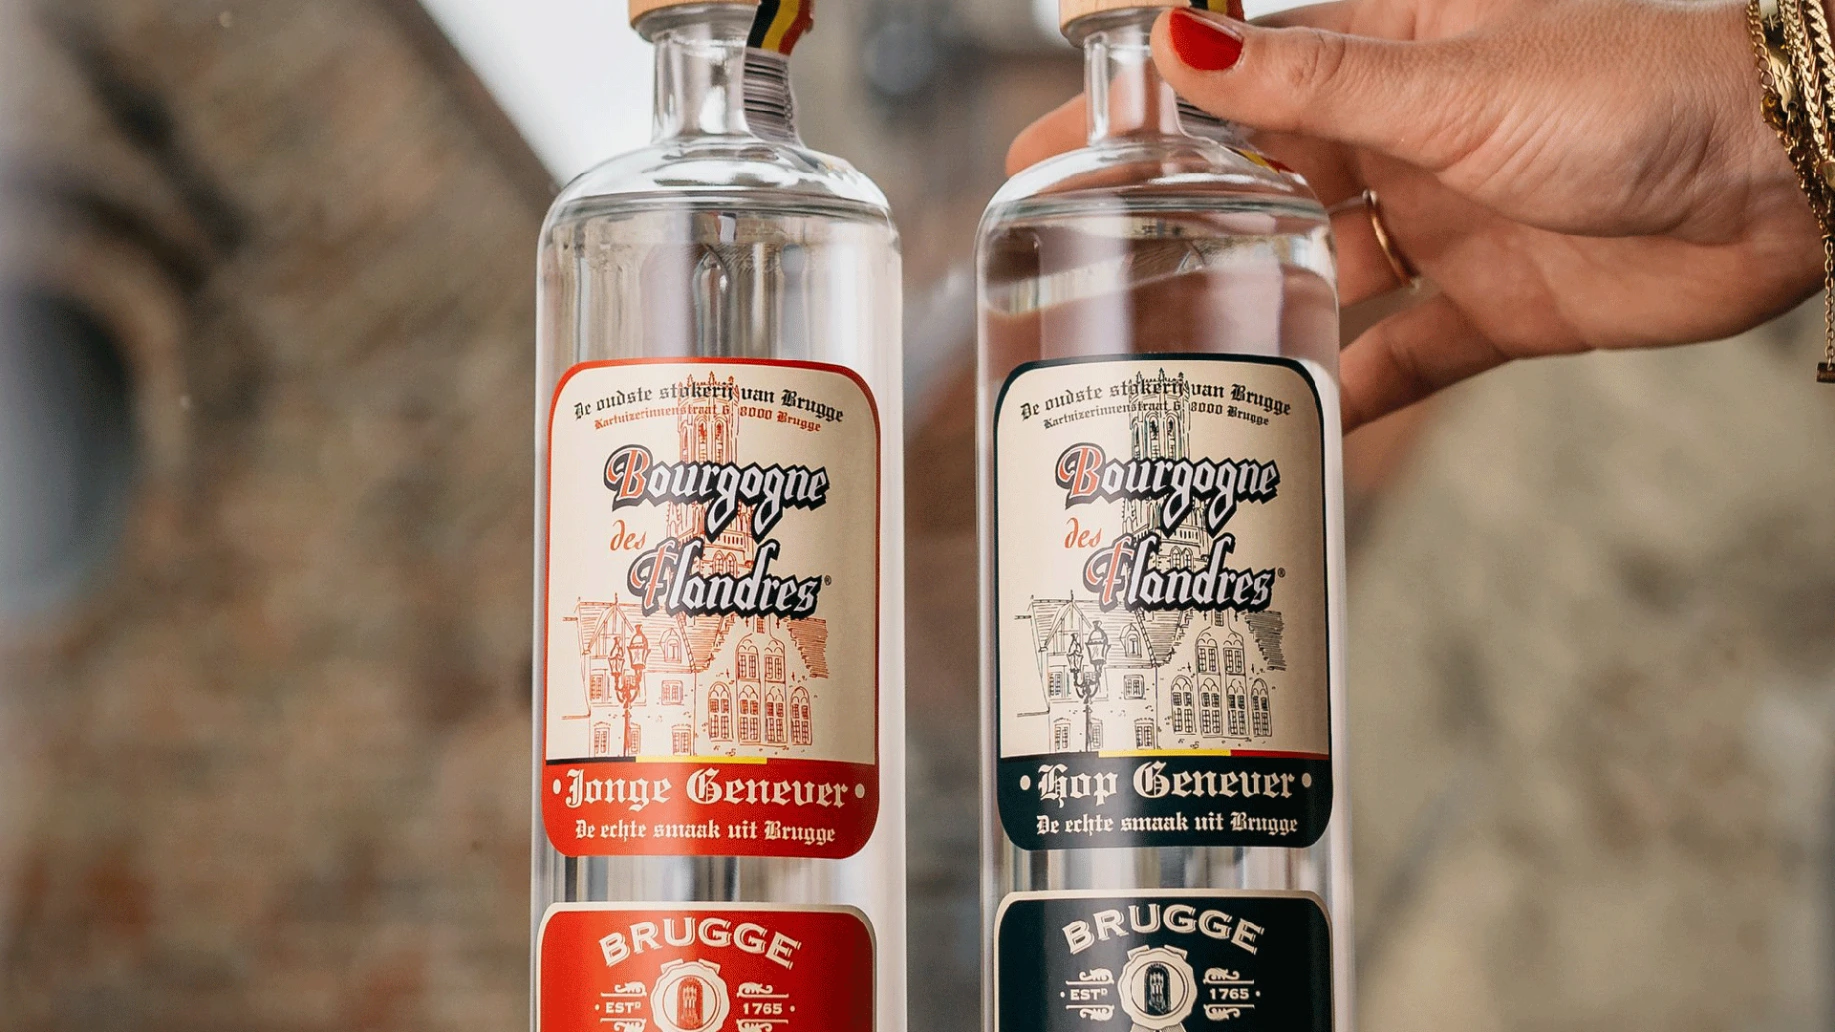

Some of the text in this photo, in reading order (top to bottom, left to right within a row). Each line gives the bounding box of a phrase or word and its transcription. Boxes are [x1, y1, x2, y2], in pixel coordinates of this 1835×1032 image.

[574, 381, 843, 422] De oudste stokerij van Brugge
[594, 404, 717, 430] Kartuizerinnenstraat
[740, 406, 773, 420] 8000
[777, 411, 821, 432] Brugge
[1020, 379, 1291, 421] De oudste stokerij van Brugge
[1191, 401, 1223, 415] 8000
[1227, 405, 1269, 426] Brugge
[604, 444, 830, 544] Bourgogne
[1055, 442, 1280, 538] Bourgogne
[610, 519, 646, 551] des
[1064, 517, 1102, 549] des
[565, 767, 848, 812] Jonge Genever
[1038, 760, 1295, 808] Hop Genever
[575, 819, 836, 845] De echte smaak uit Brugge
[1036, 811, 1298, 836] De echte smaak uit Brugge
[599, 916, 802, 970] BRUGGE
[1062, 903, 1265, 956] BRUGGE
[743, 1002, 783, 1015] 1765
[1210, 988, 1250, 1000] 1765
